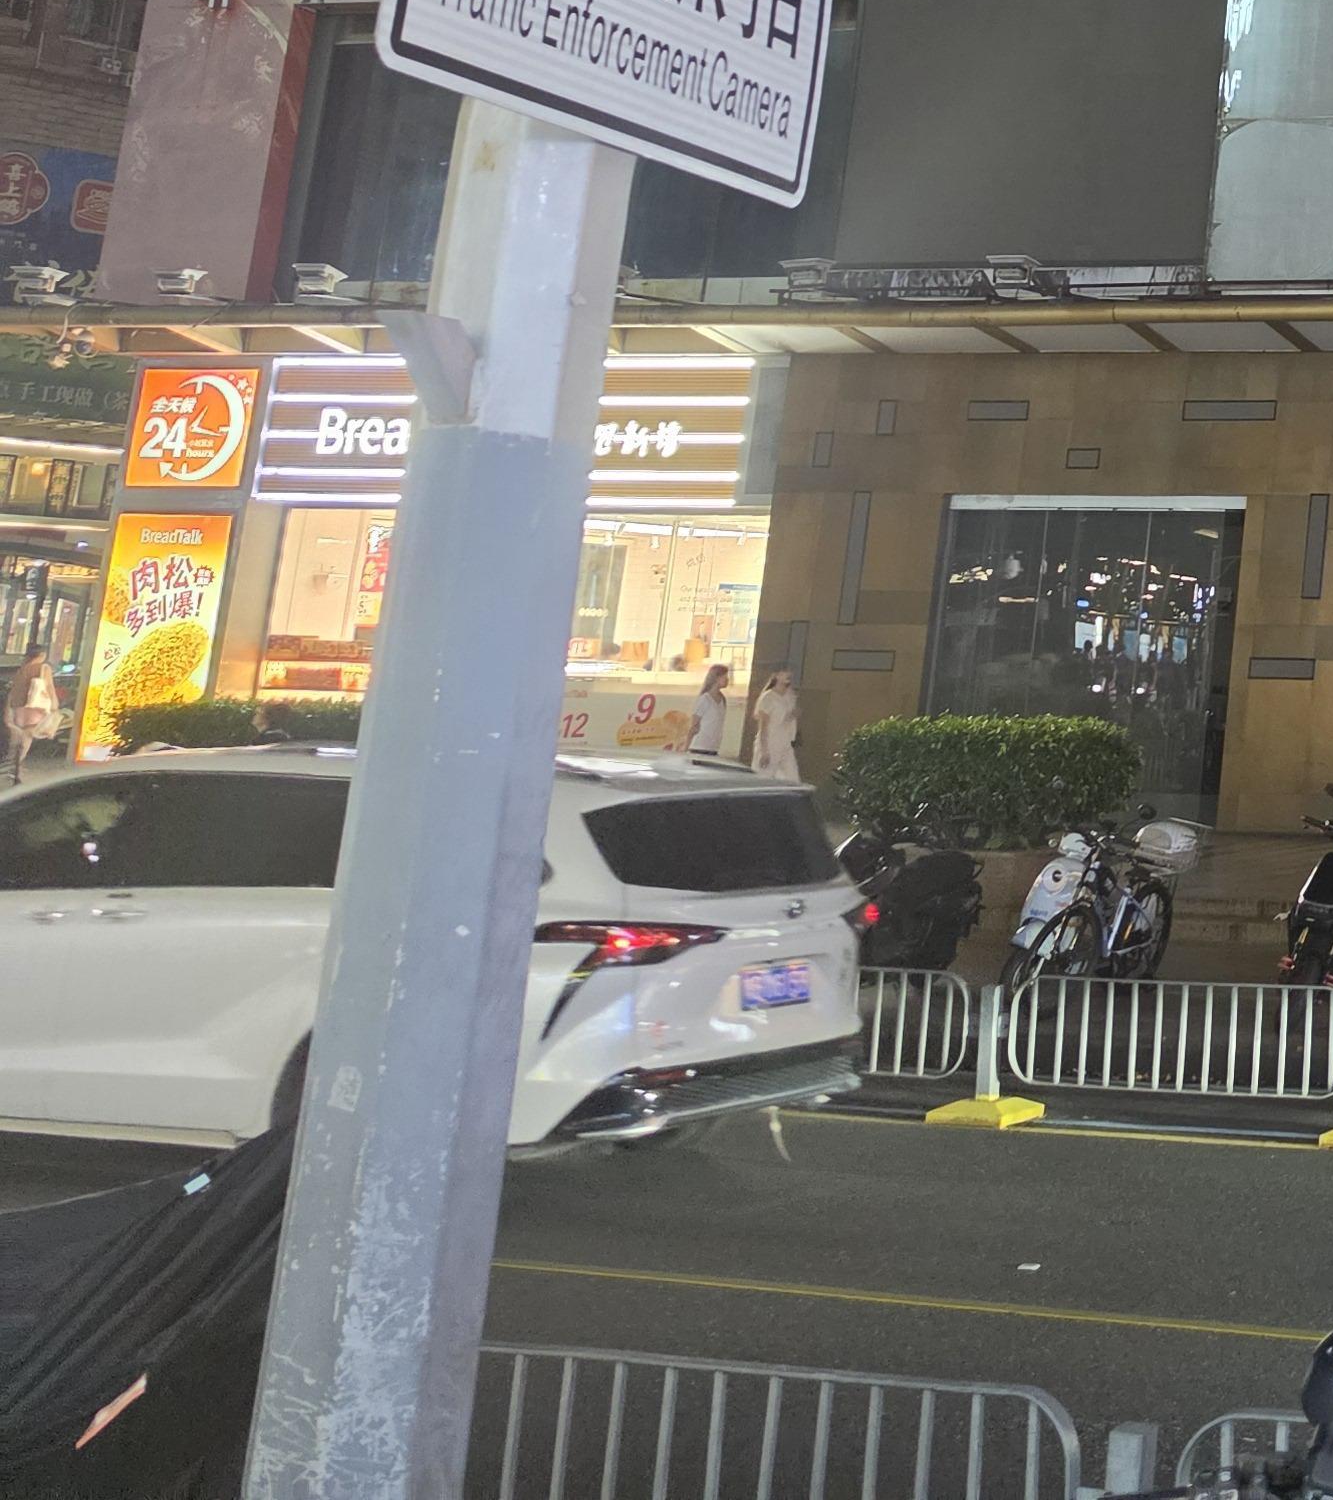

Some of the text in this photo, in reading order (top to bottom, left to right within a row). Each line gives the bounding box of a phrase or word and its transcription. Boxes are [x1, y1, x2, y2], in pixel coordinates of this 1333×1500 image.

[709, 51, 792, 140] Camera
[140, 416, 189, 458] 24
[140, 528, 203, 545] BreadTalk
[131, 555, 191, 601] 肉松
[561, 712, 589, 739] 12
